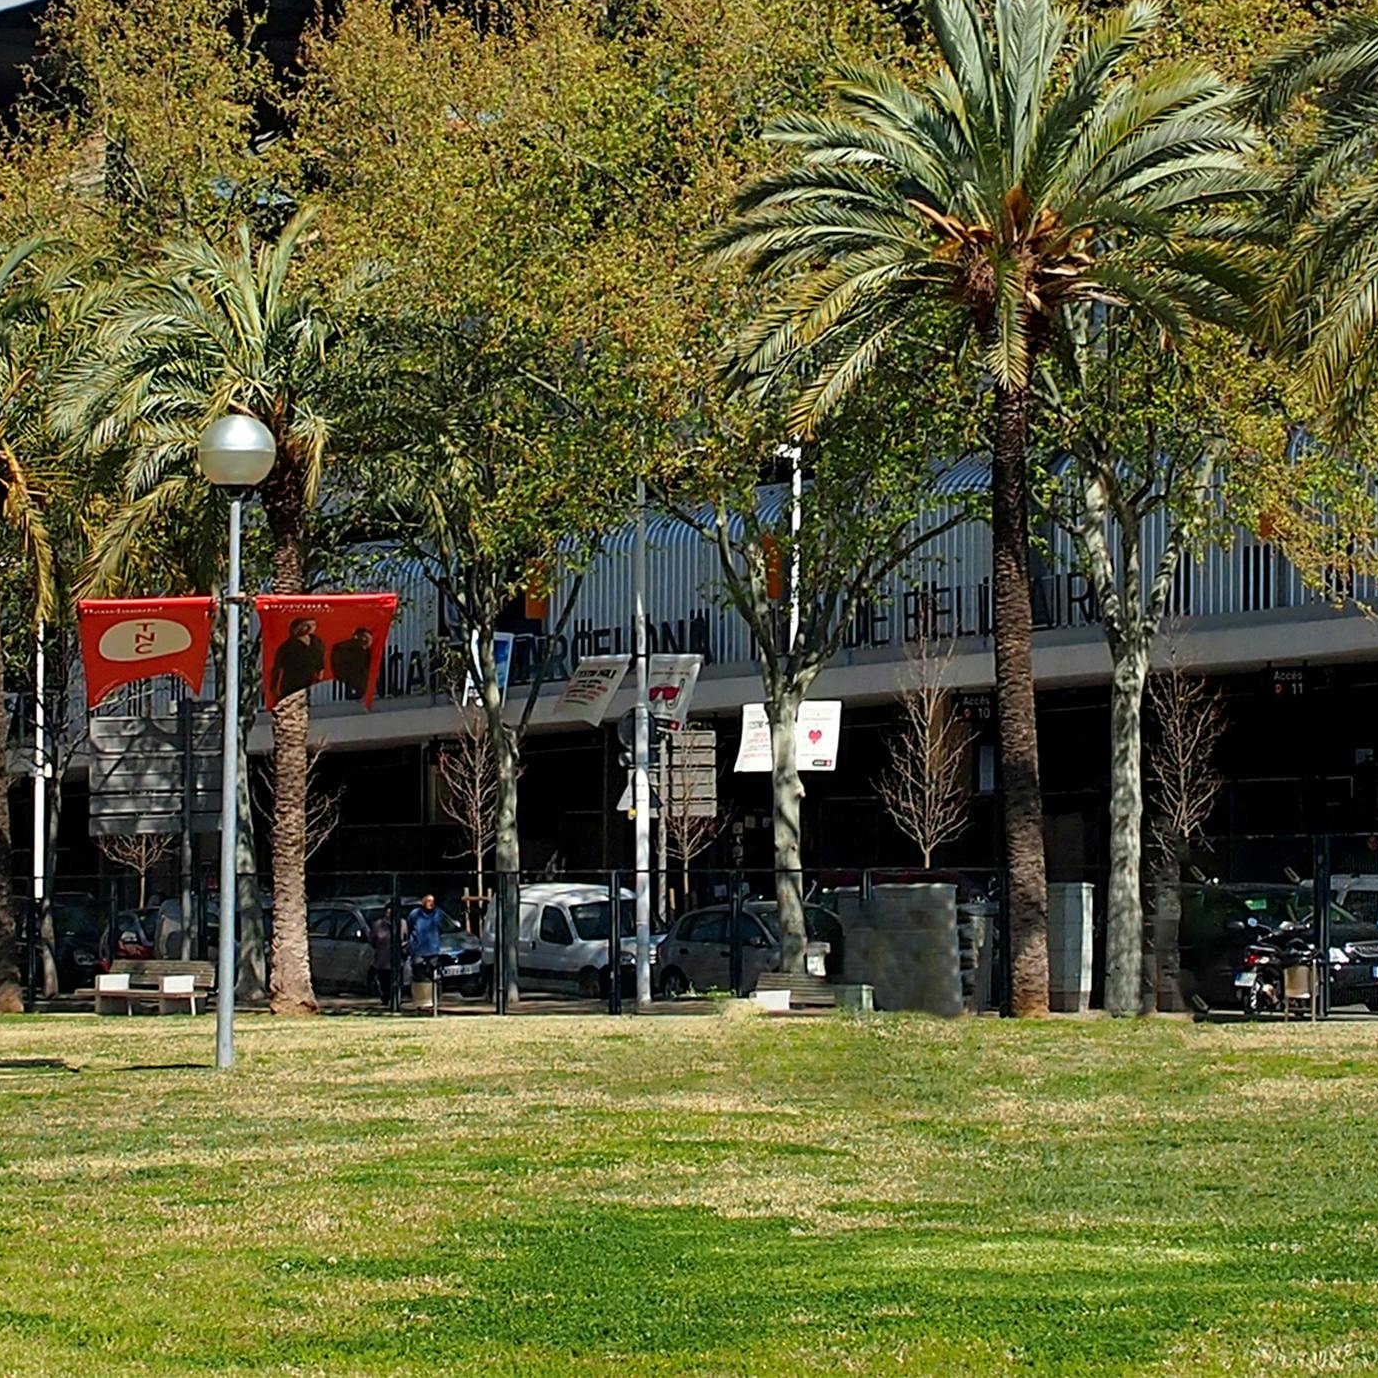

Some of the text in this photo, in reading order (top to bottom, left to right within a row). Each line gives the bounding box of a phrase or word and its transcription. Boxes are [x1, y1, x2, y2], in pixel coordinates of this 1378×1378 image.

[134, 622, 155, 654] TNC
[1292, 682, 1303, 695] 11
[978, 707, 991, 719] 10
